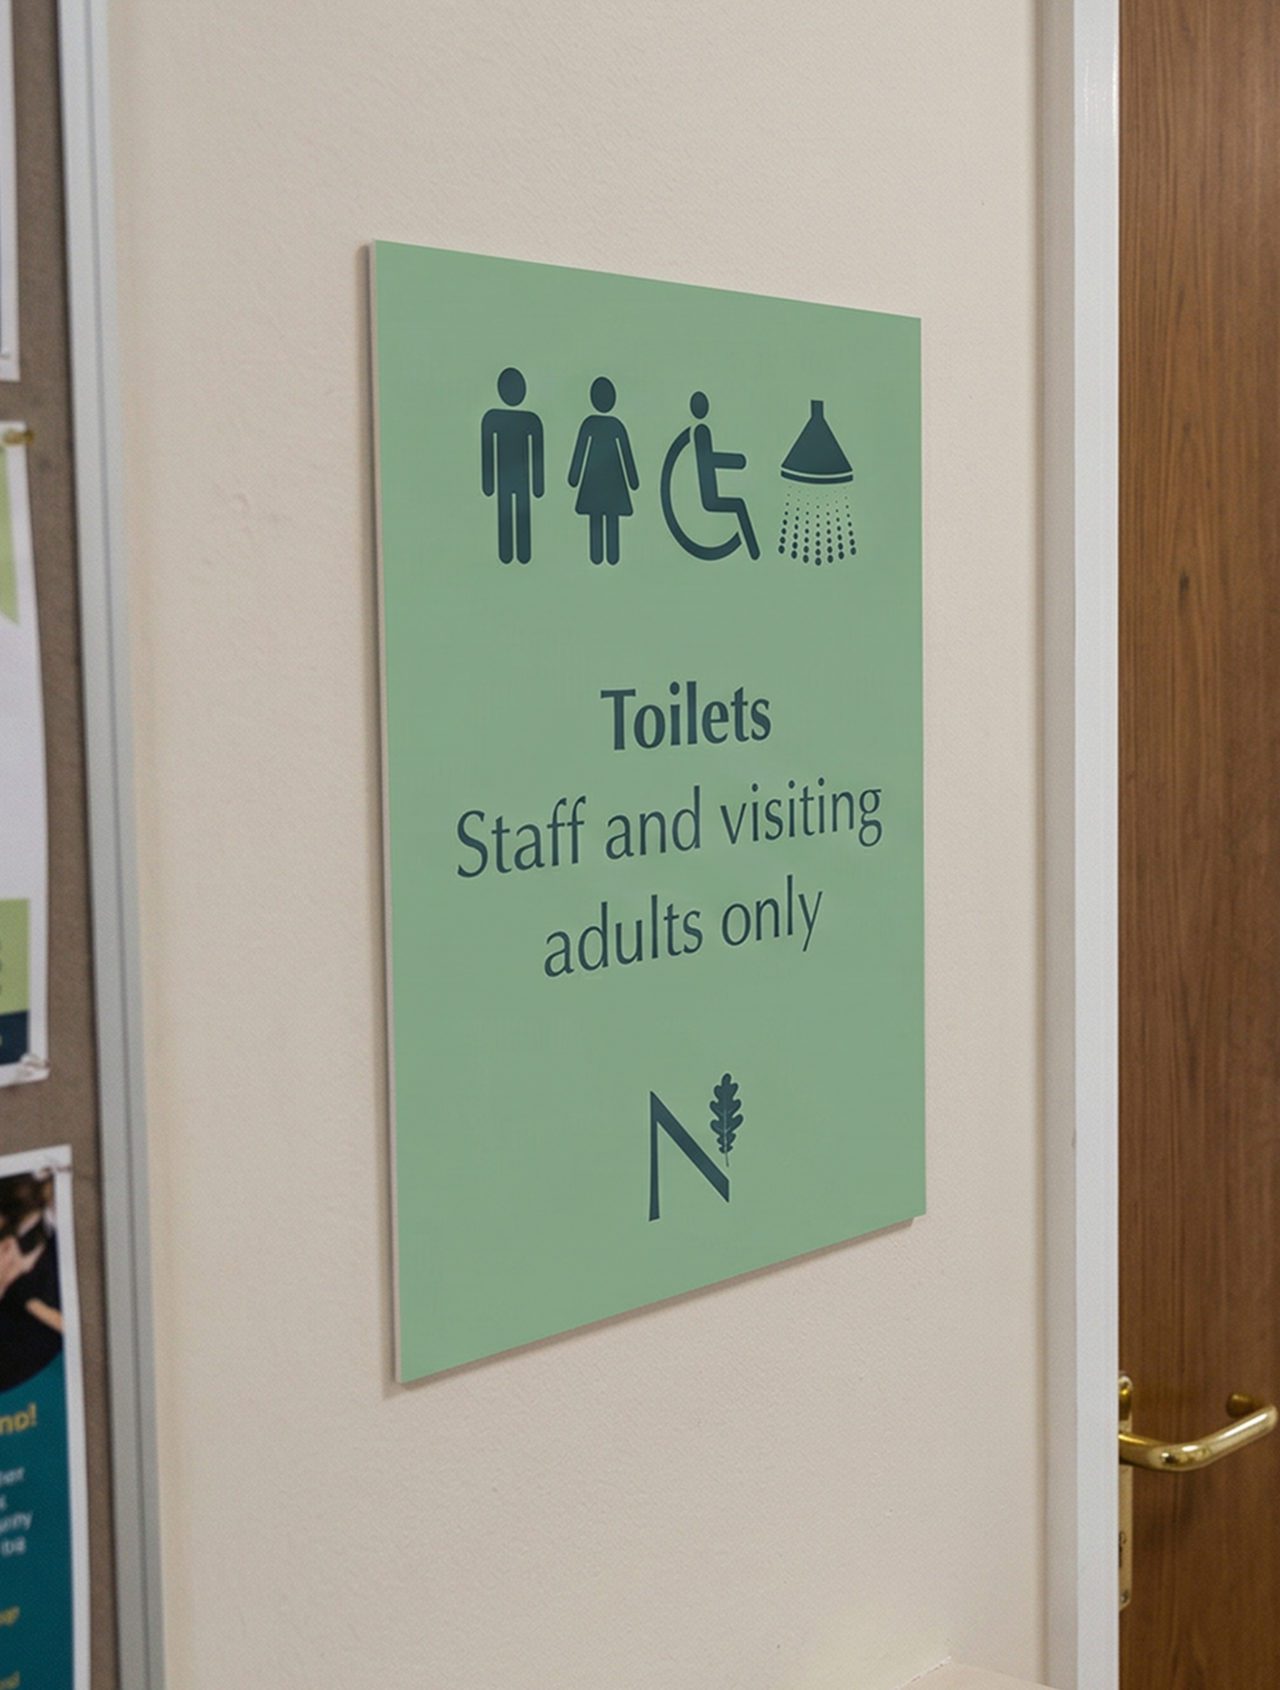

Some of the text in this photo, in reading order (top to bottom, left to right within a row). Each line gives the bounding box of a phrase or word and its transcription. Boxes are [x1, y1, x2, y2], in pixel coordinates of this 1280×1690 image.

[600, 680, 771, 751] Toilets
[457, 777, 882, 878] Staff and visiting
[544, 874, 823, 977] adults only
